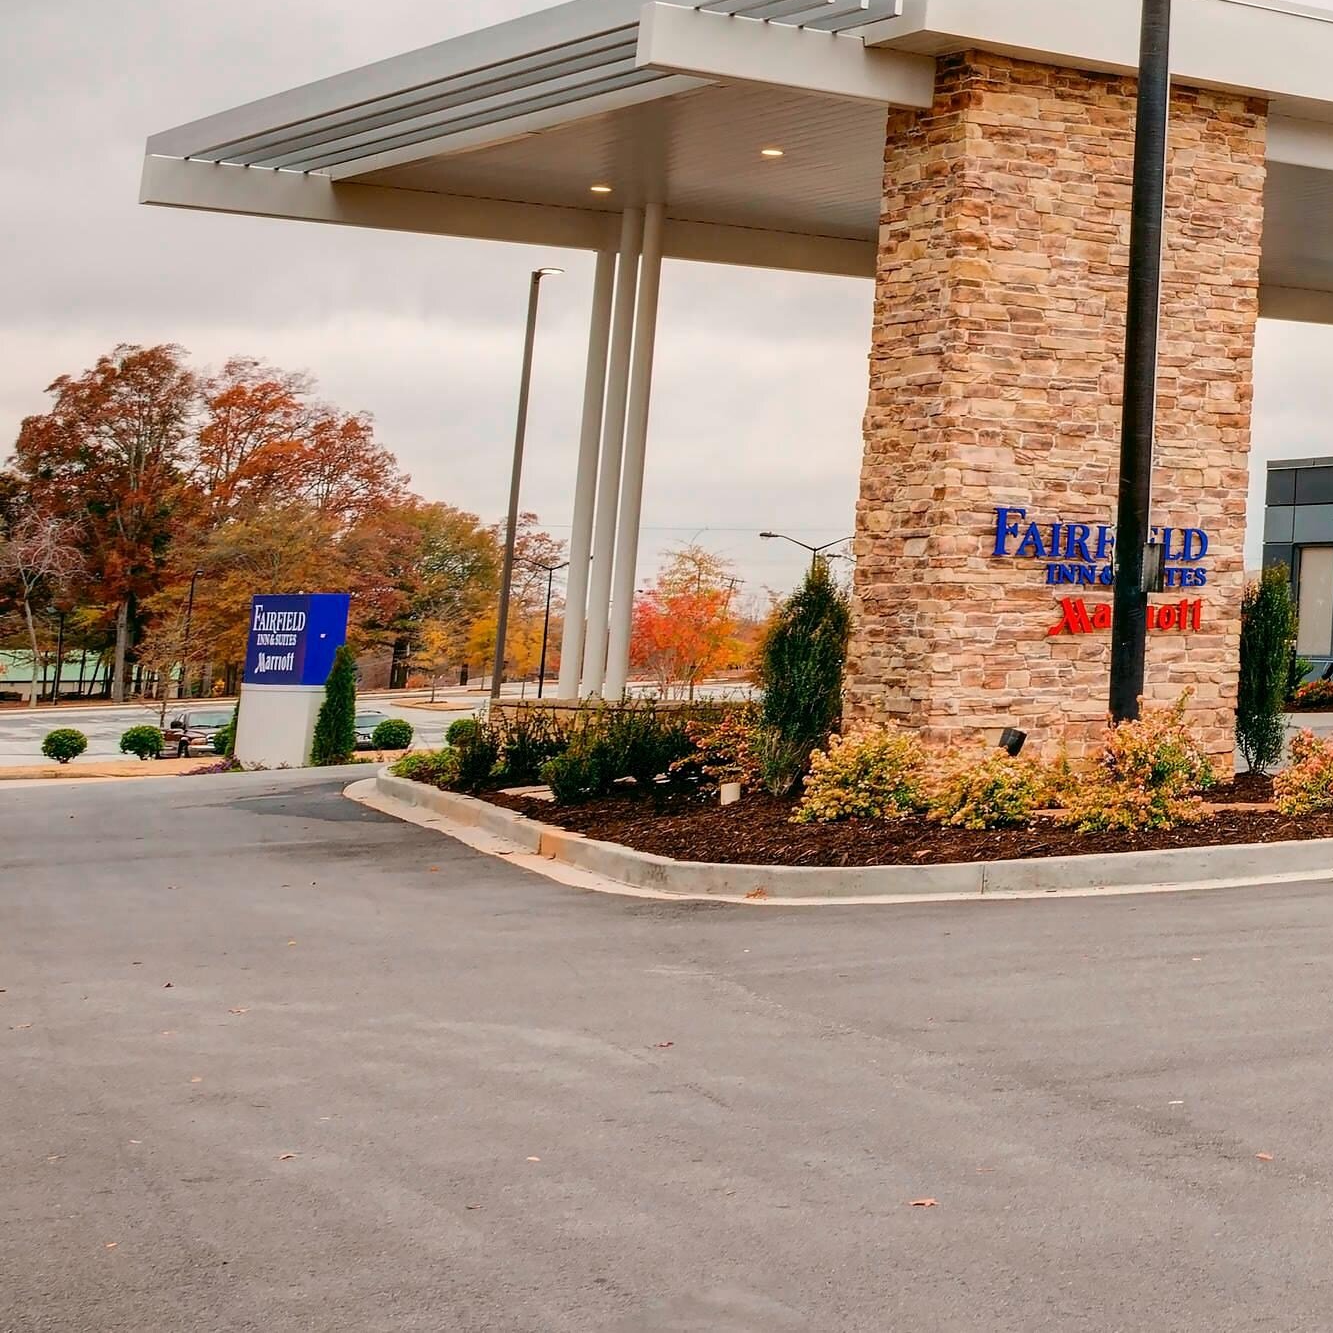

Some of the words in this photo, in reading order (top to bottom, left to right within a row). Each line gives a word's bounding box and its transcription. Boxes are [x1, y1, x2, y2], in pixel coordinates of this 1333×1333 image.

[992, 507, 1208, 563] FAIRFLD
[1046, 563, 1096, 585] INN
[253, 604, 306, 634] FAIRFIELD
[1048, 596, 1203, 636] Maiott
[254, 651, 295, 674] Marriott
